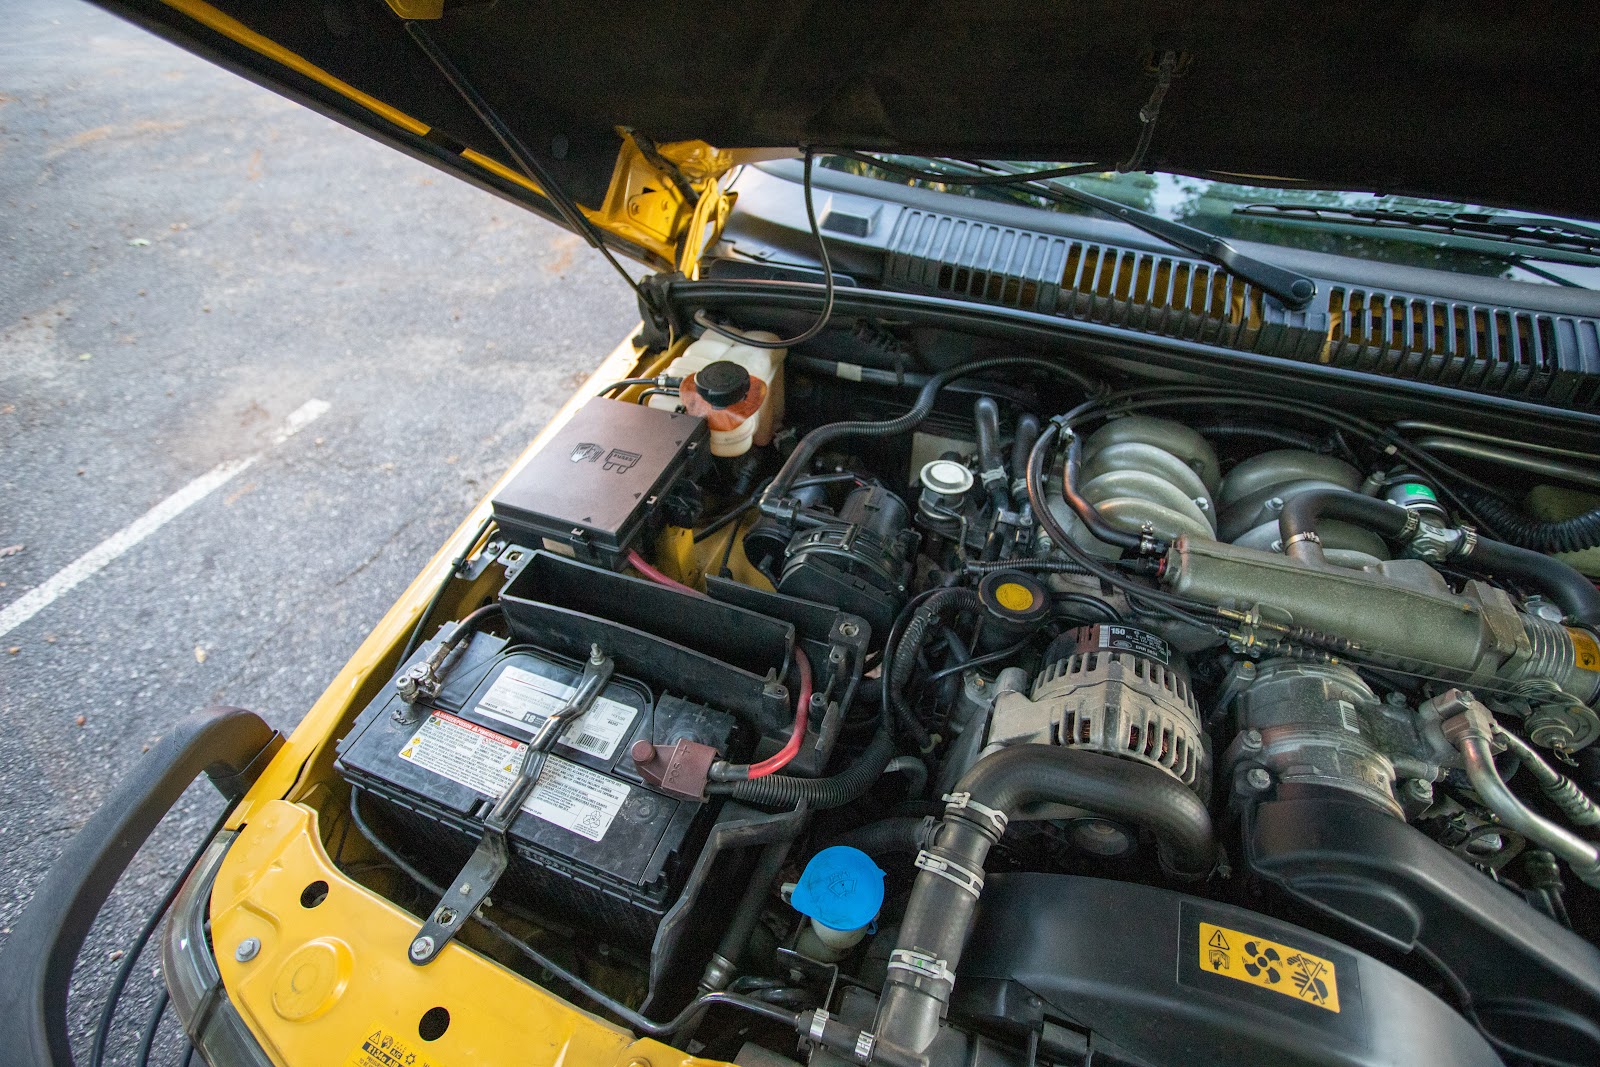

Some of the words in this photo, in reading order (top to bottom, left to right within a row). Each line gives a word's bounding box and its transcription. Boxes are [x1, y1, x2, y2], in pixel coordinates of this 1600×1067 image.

[524, 713, 536, 723] 18
[669, 762, 682, 783] POS
[367, 1045, 387, 1062] R134a
